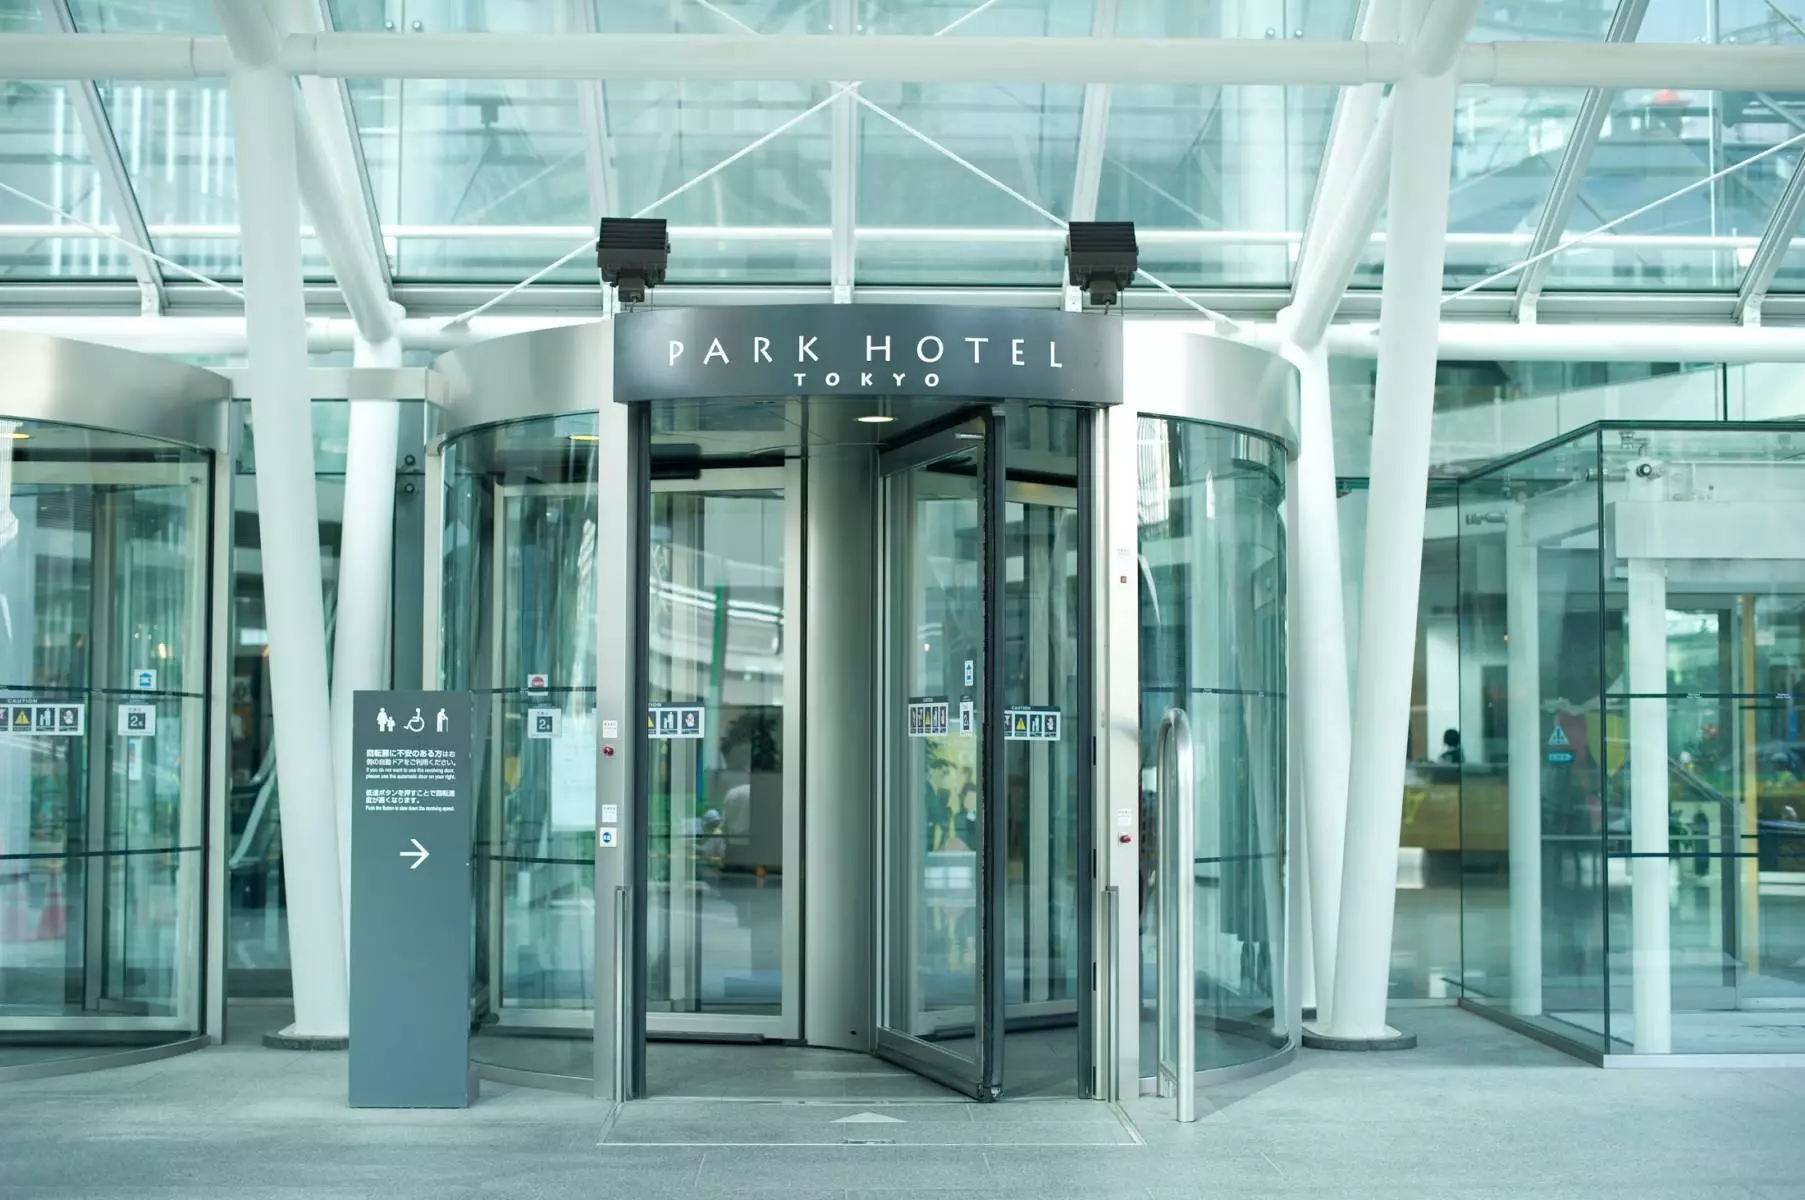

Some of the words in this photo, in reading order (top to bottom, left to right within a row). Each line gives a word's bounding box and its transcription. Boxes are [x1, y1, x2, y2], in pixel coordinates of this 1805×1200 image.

[669, 335, 819, 367] PARK
[866, 335, 1063, 368] HOTEL
[793, 372, 940, 387] TOKYO
